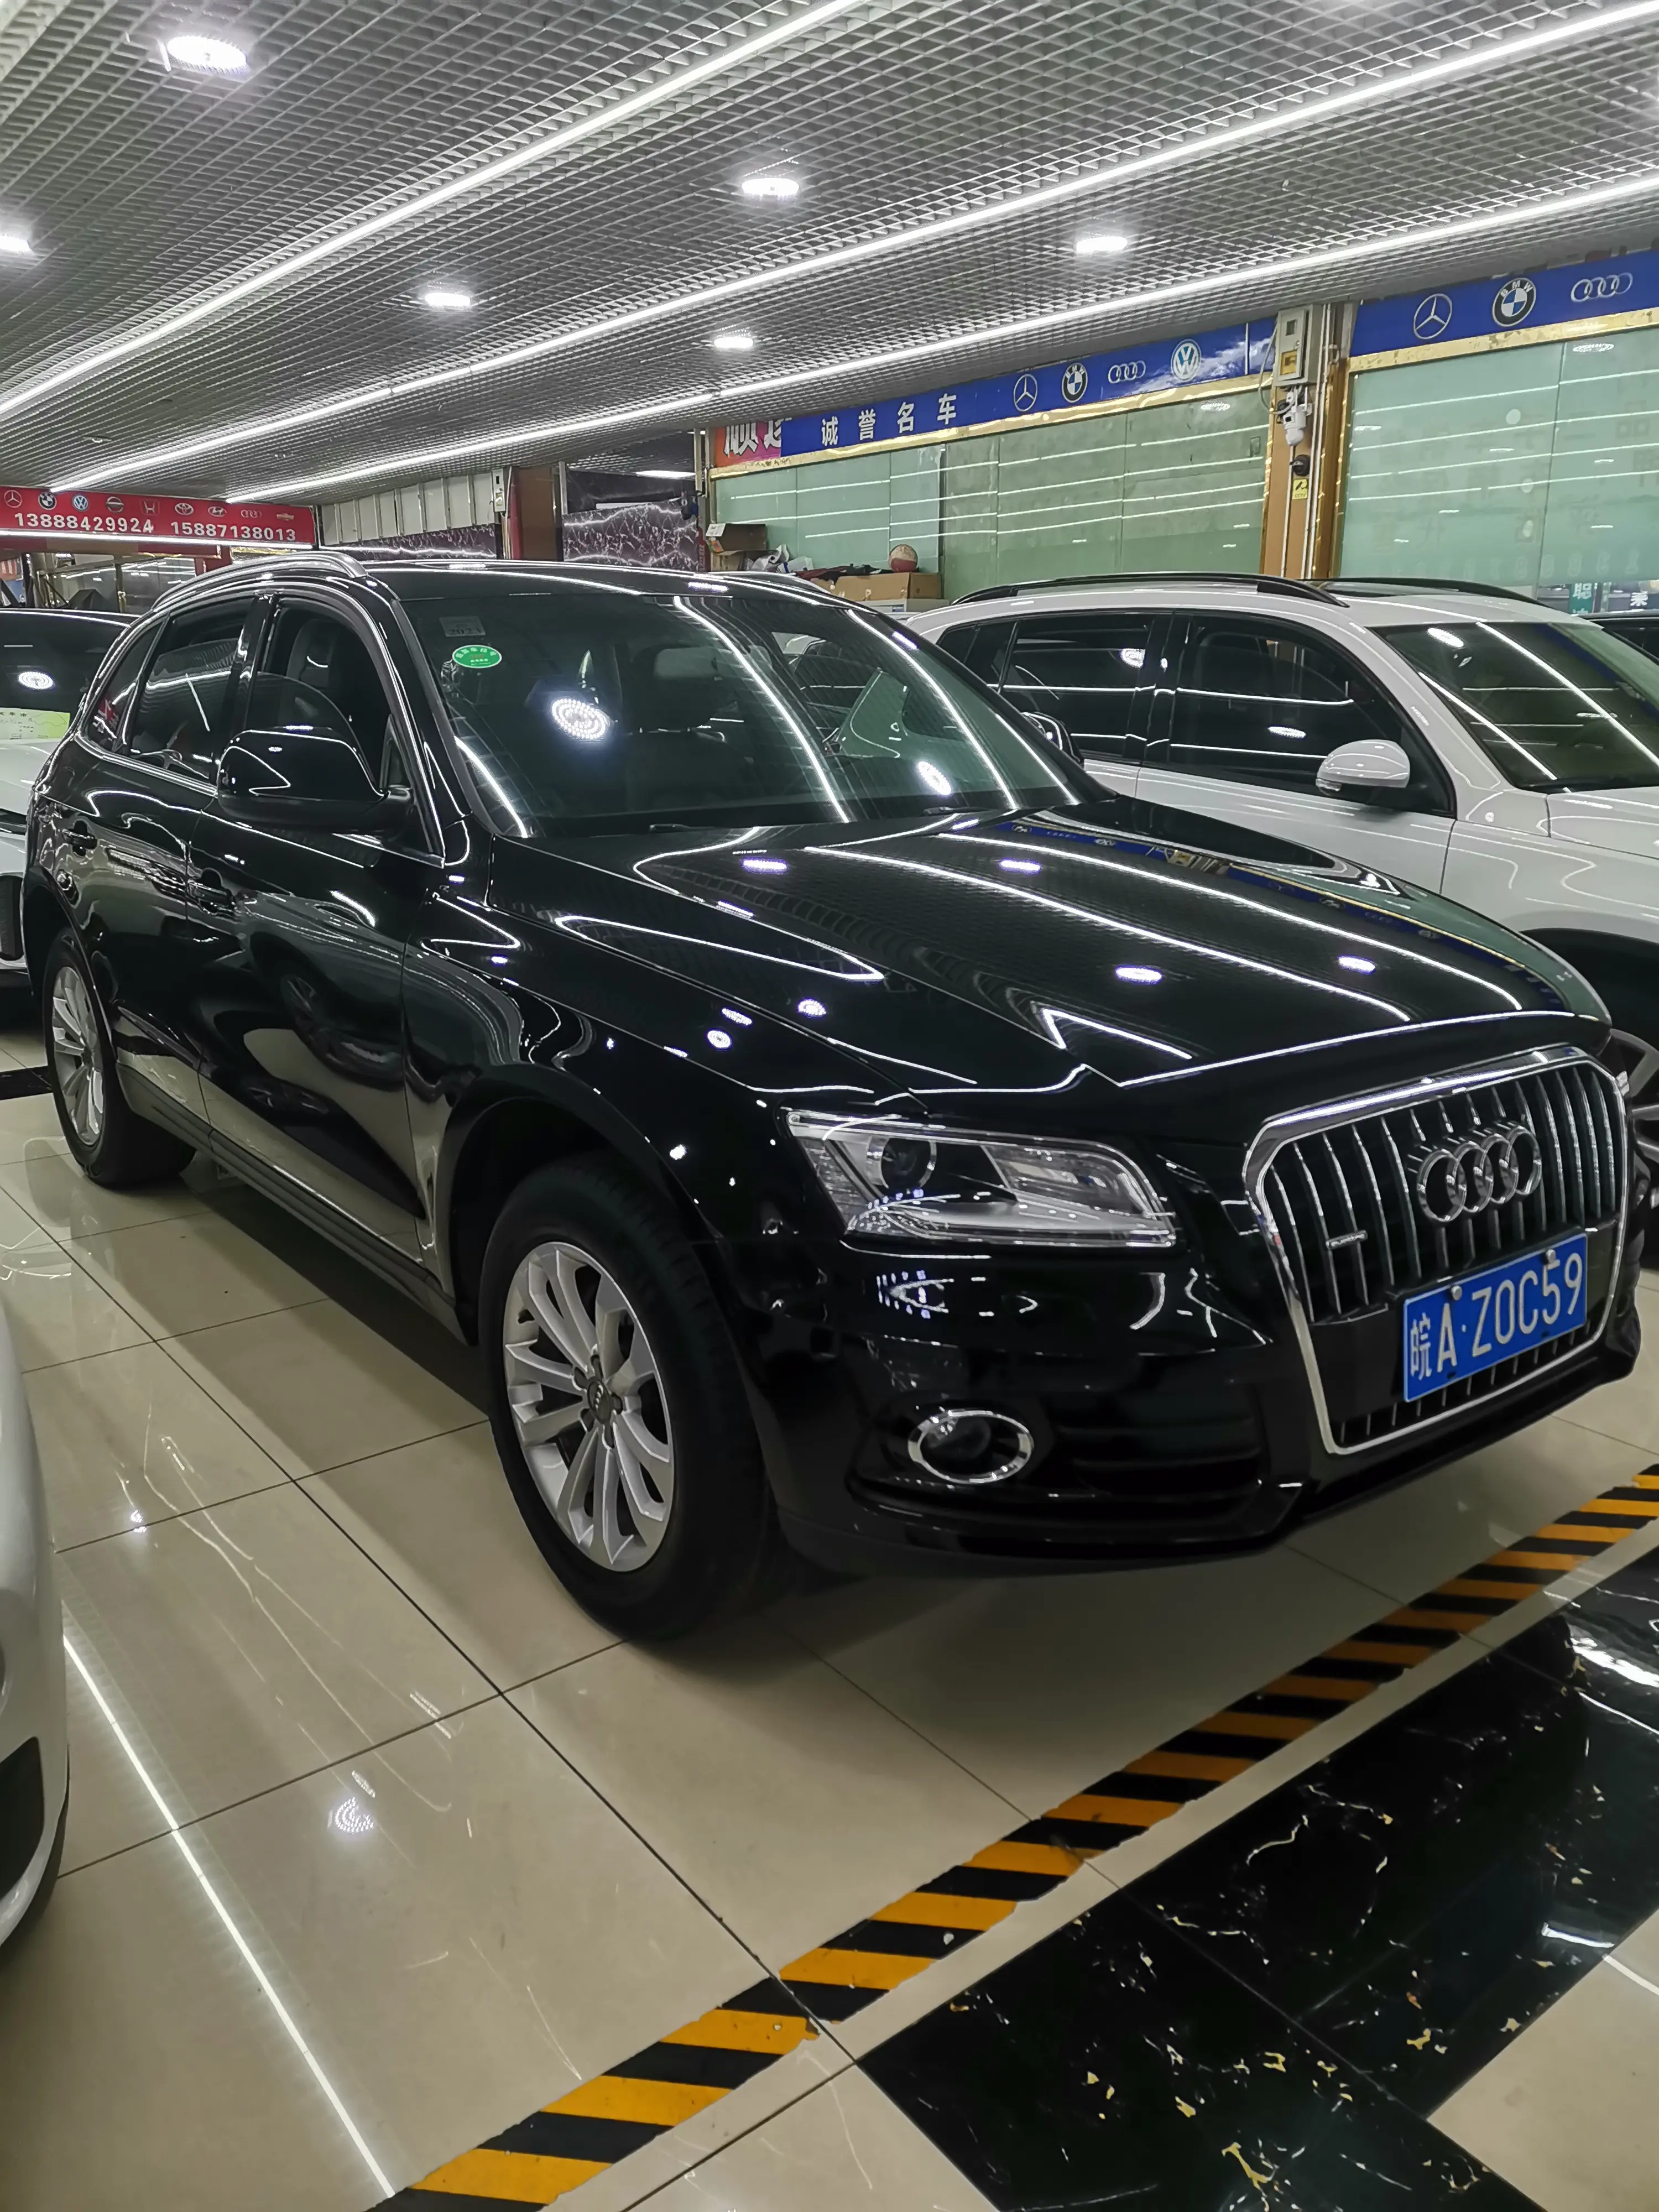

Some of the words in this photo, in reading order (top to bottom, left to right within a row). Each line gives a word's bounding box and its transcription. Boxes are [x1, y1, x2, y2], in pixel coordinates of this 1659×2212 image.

[821, 393, 957, 446] 诚誉名车
[14, 513, 154, 533] 13888429924
[171, 521, 296, 541] 15887138013
